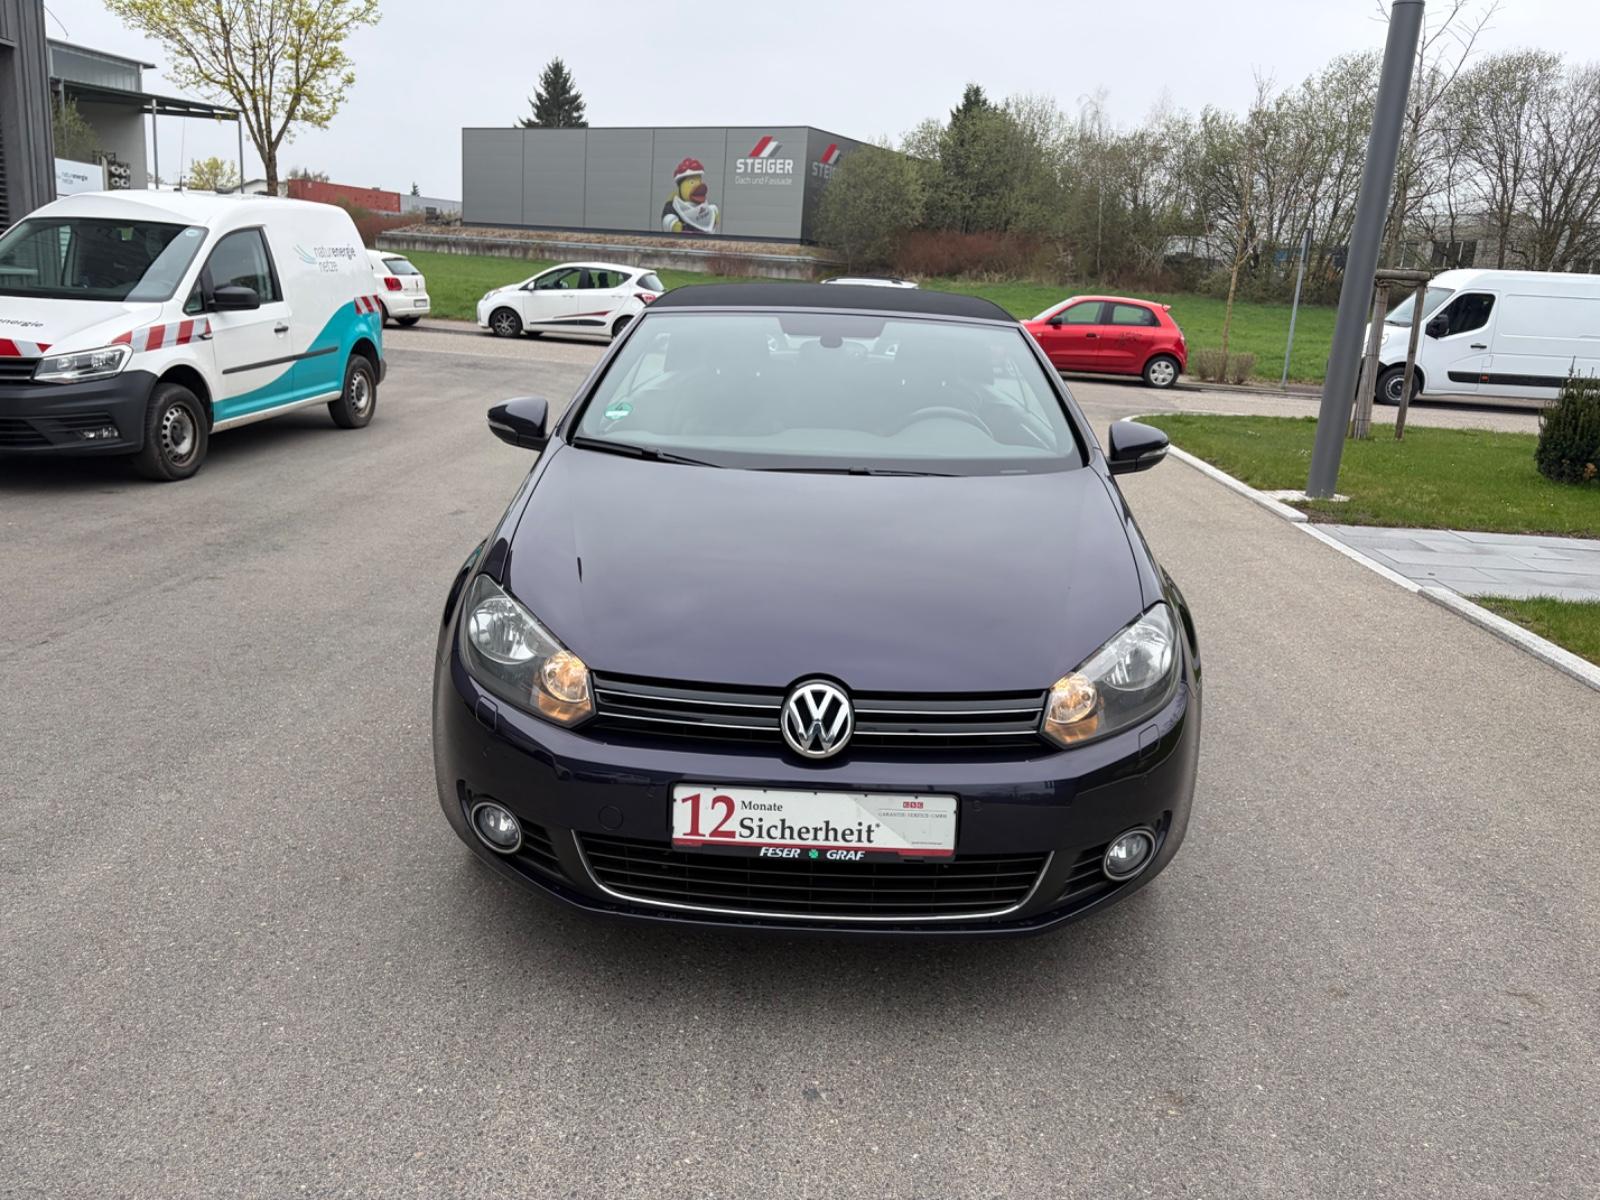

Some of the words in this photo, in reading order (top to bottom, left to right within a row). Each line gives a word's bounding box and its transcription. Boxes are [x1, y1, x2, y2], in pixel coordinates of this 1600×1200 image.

[736, 159, 793, 174] STEIGER
[314, 244, 356, 260] naturenergie
[318, 260, 338, 272] netze
[740, 800, 783, 812] Monate
[681, 793, 736, 839] 12
[759, 846, 801, 859] FESER
[826, 849, 866, 861] GRAF
